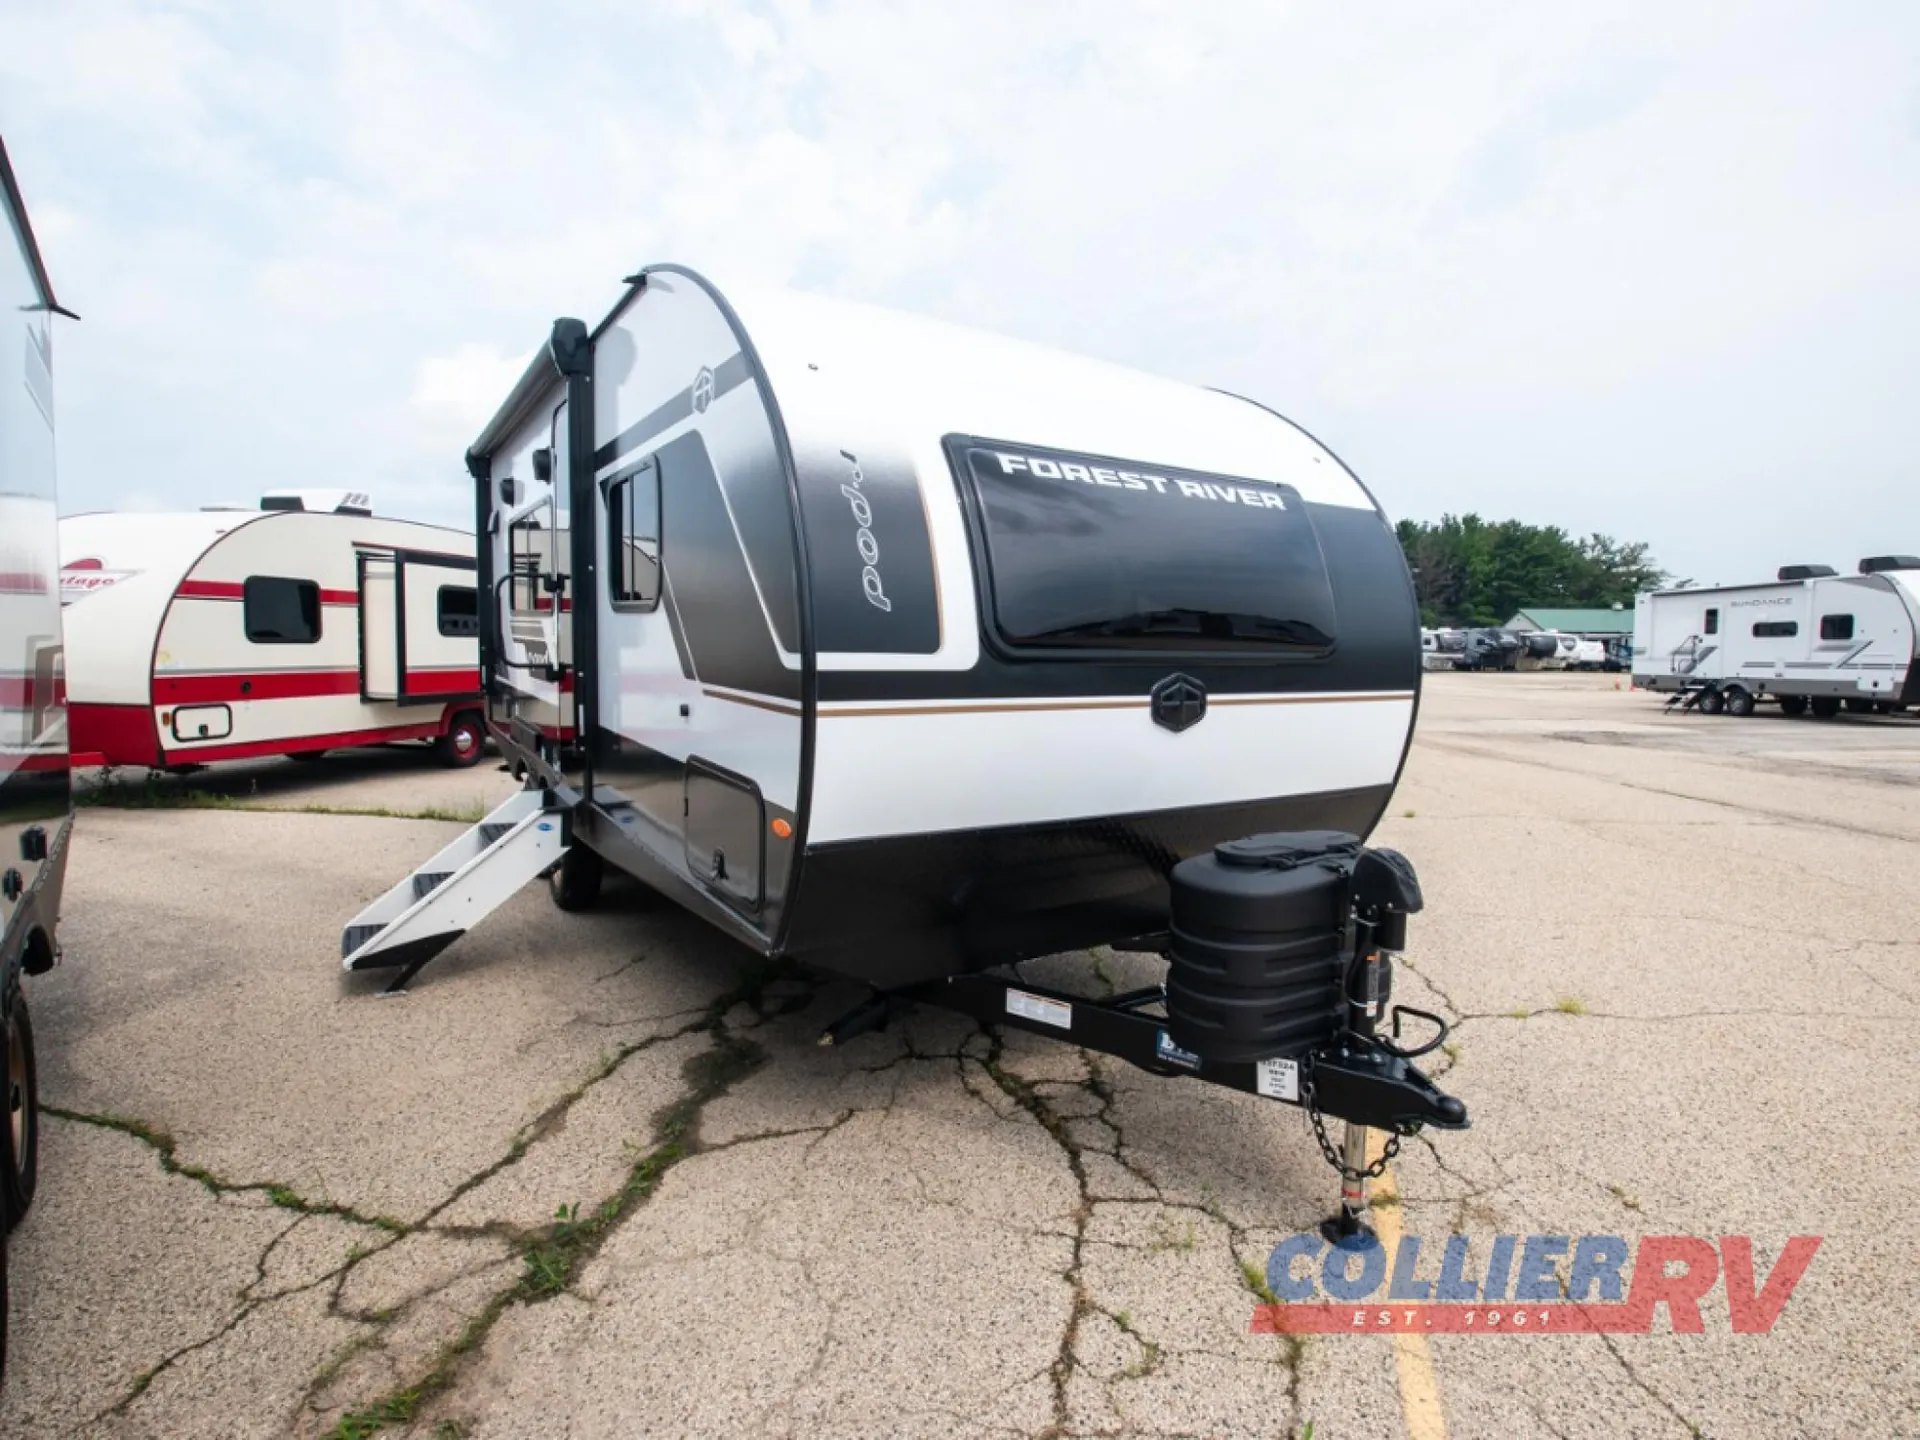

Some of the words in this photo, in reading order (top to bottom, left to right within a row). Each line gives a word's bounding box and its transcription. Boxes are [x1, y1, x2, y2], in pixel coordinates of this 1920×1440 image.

[995, 451, 1168, 494] FOREST
[1175, 479, 1287, 511] RIVER
[1730, 597, 1793, 608] SUNDANCE
